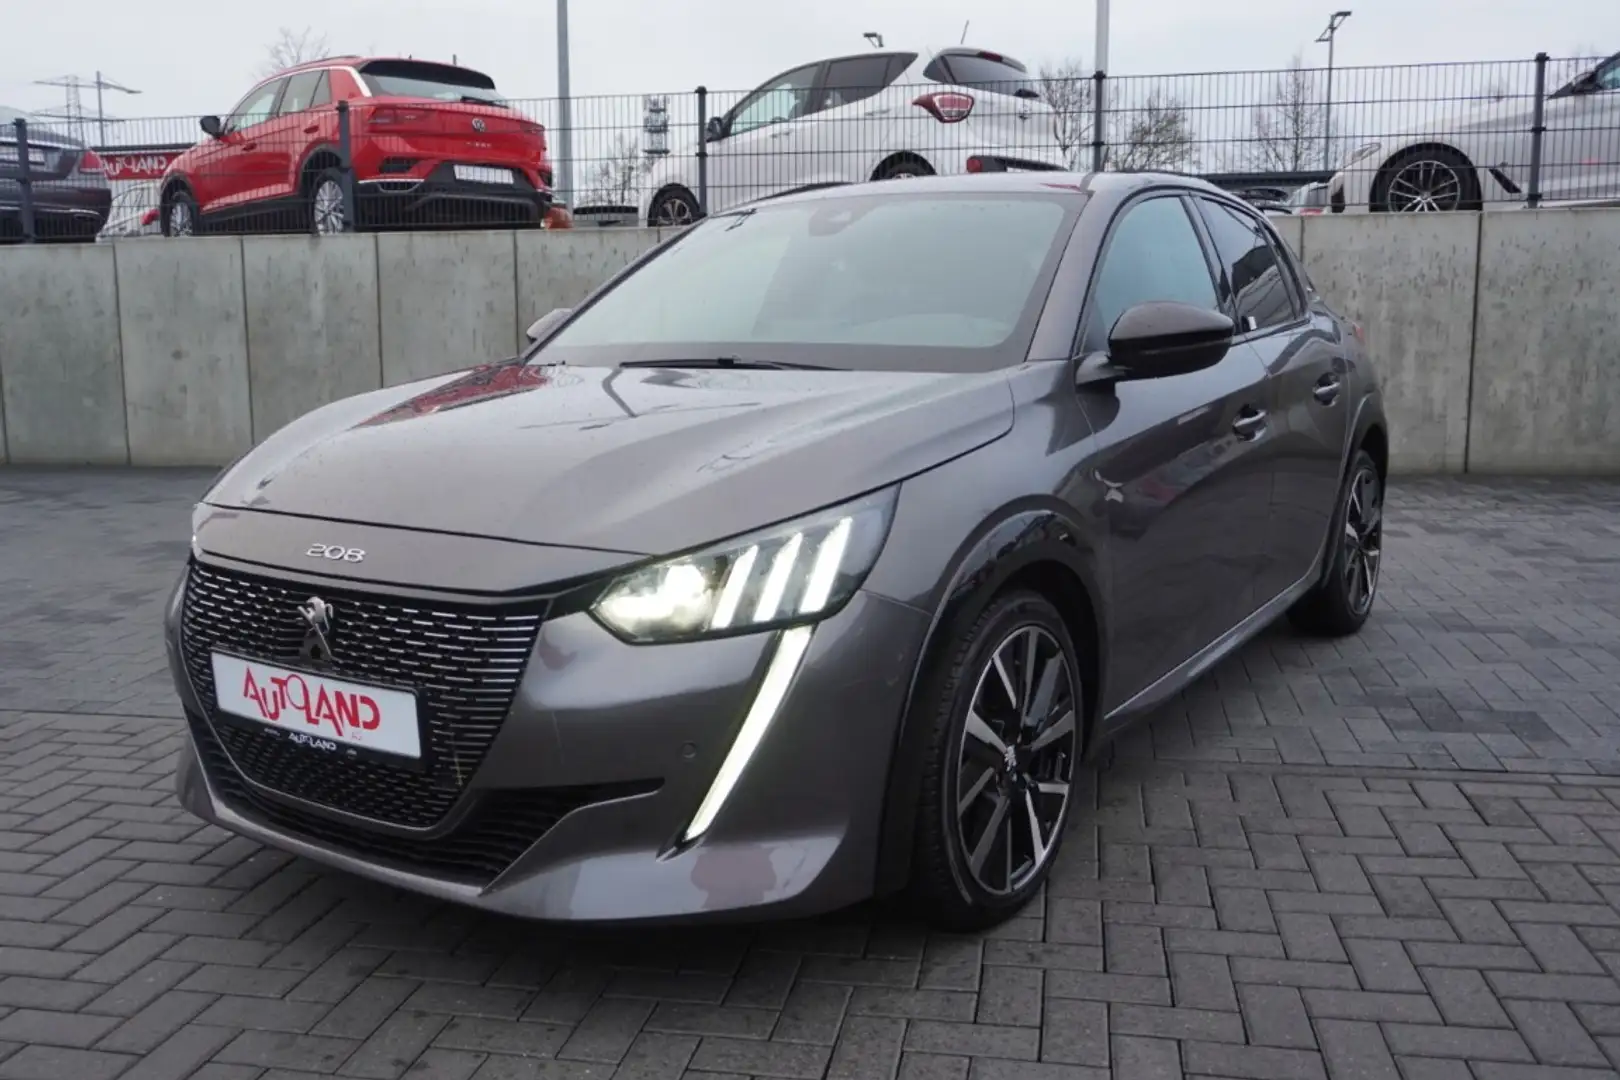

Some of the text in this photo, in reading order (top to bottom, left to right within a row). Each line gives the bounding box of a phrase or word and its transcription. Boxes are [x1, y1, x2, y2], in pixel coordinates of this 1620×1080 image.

[305, 543, 366, 563] 208
[243, 667, 381, 737] AUTOLAND
[288, 732, 337, 751] AUTOLAND
